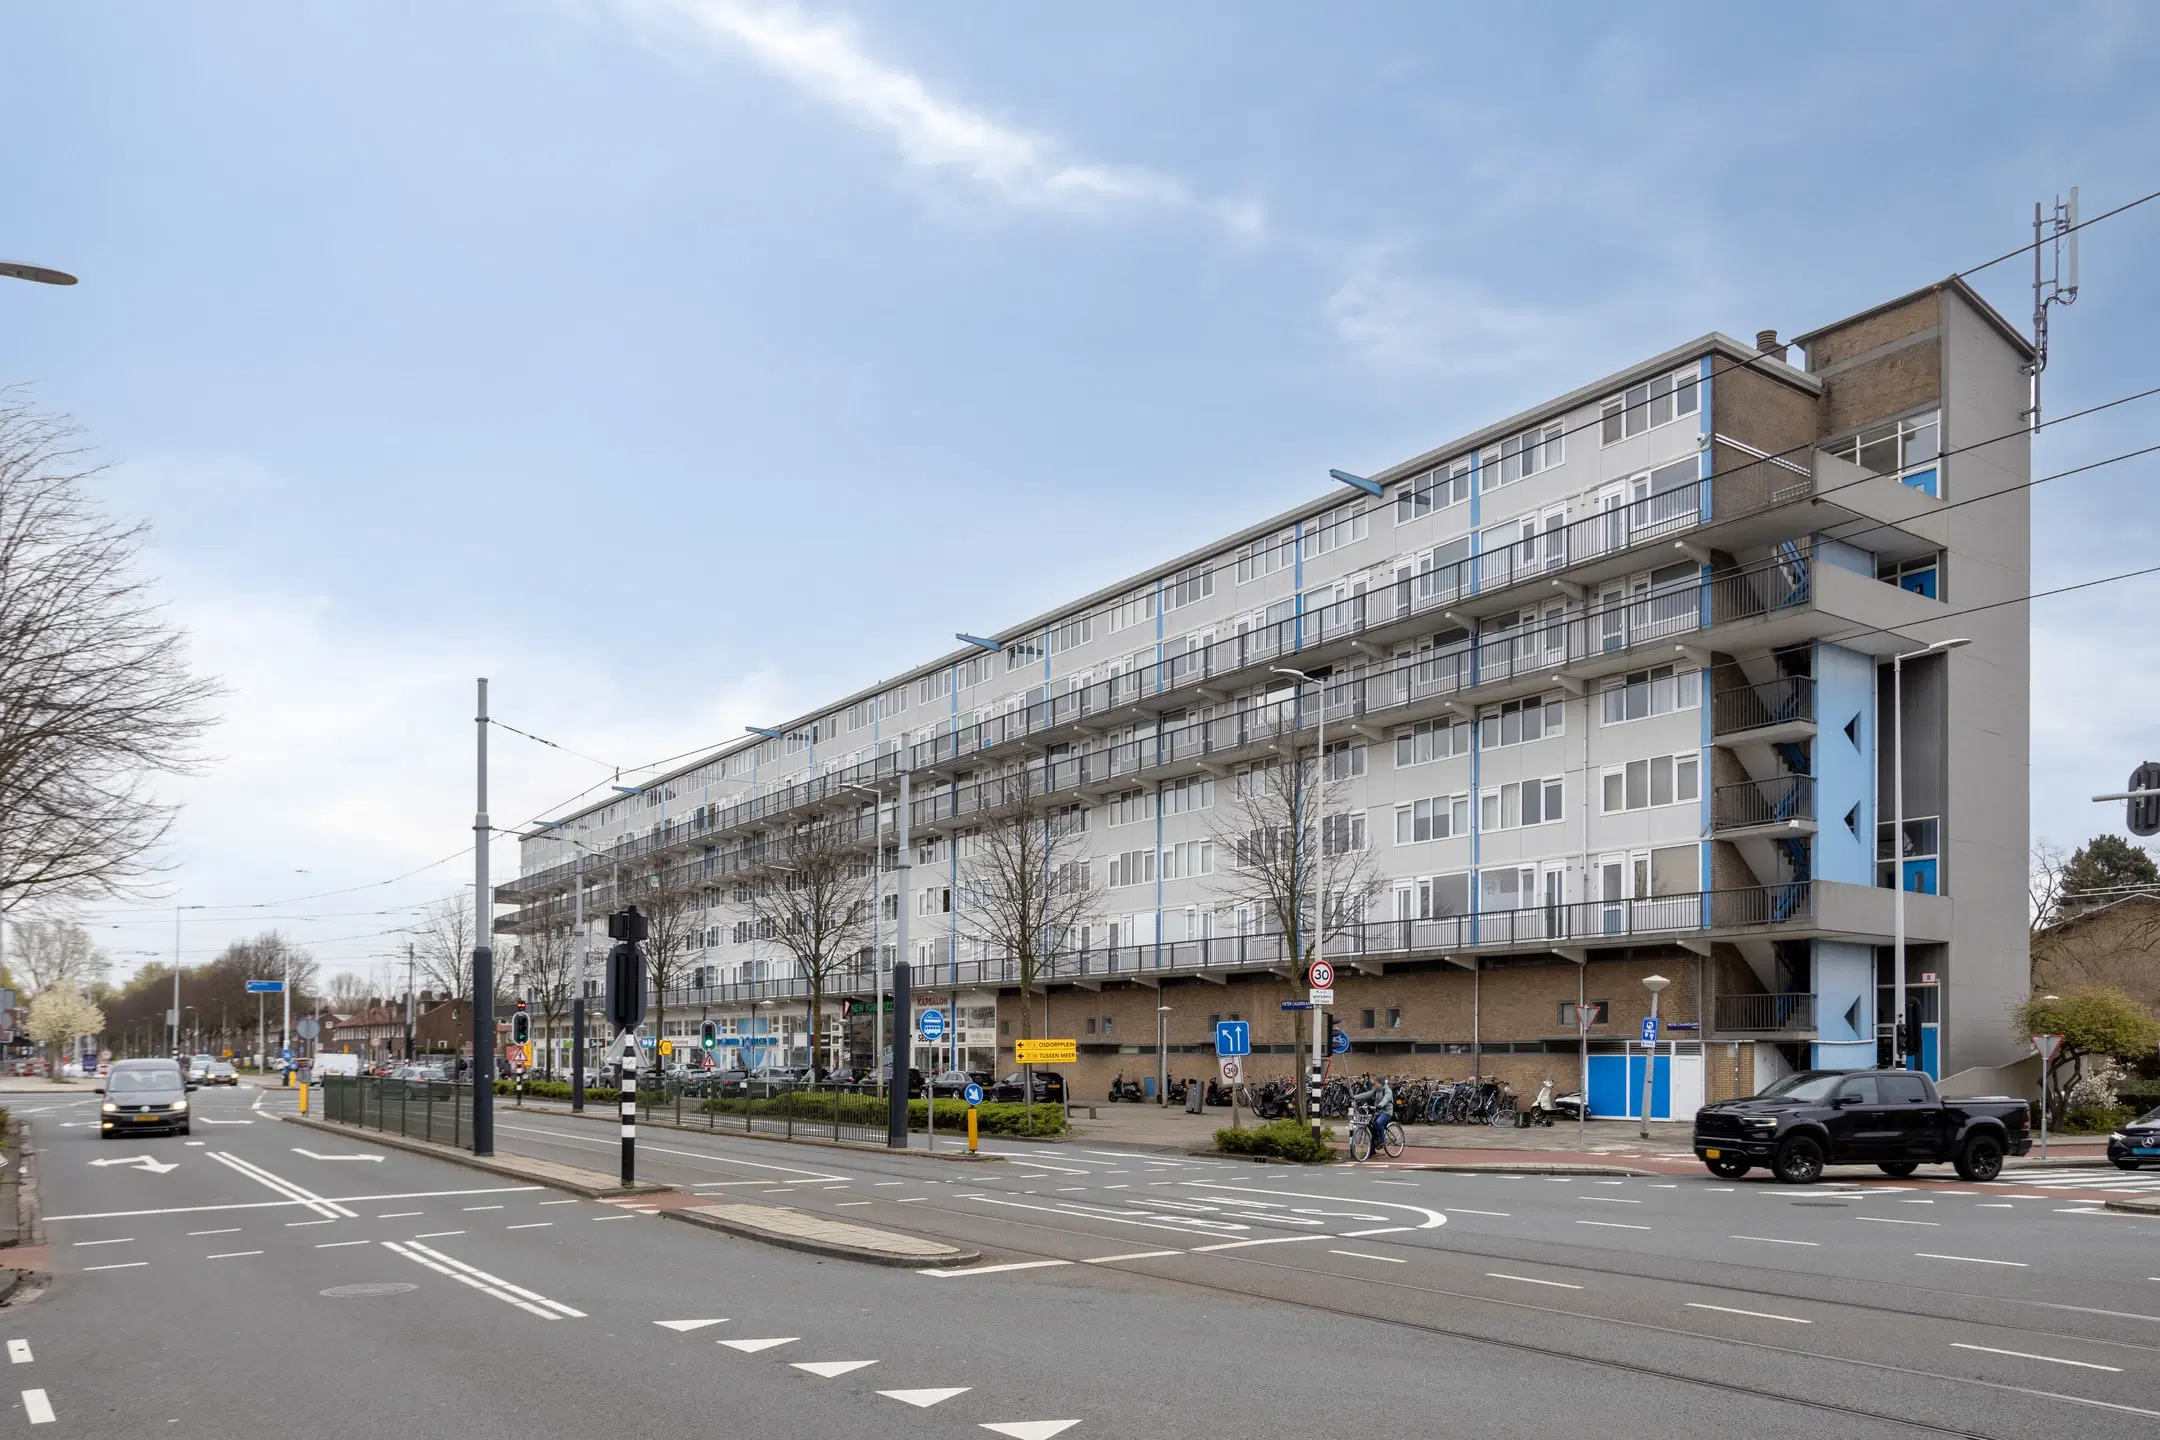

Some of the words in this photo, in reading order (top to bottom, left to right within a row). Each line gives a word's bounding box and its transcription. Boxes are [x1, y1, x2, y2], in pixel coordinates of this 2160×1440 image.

[1314, 969, 1329, 980] 30
[917, 996, 949, 1006] KAPSALON
[851, 1003, 865, 1012] NEW
[1144, 1208, 1390, 1230] BUS
